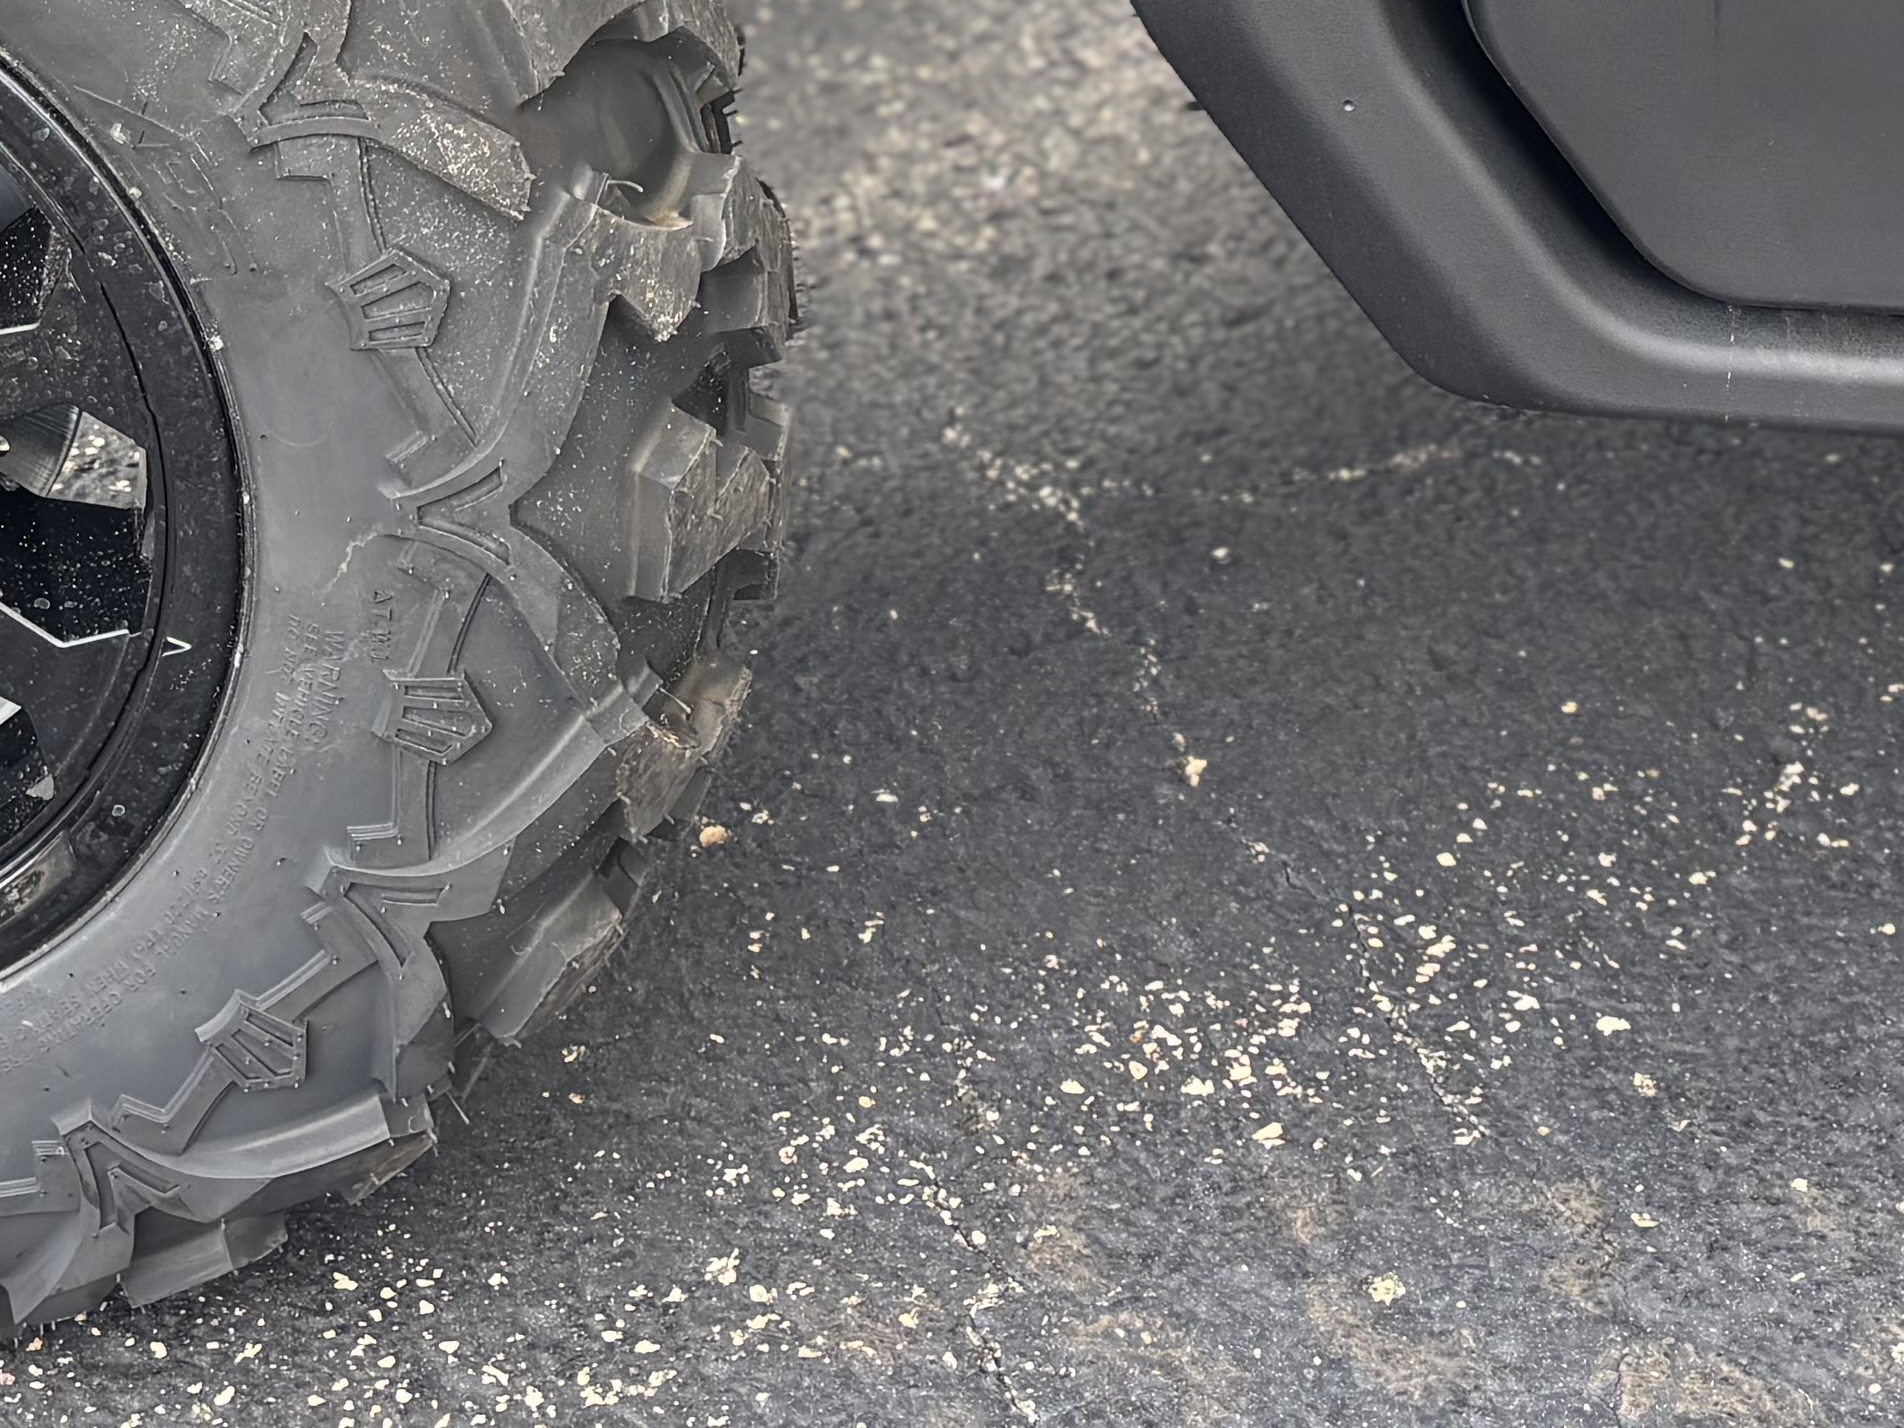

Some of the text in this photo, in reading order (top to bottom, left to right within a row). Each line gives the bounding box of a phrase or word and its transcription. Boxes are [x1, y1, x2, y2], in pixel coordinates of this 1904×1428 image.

[284, 663, 317, 740] VEHICLE
[263, 744, 295, 800] LABEL
[247, 805, 271, 833] OR
